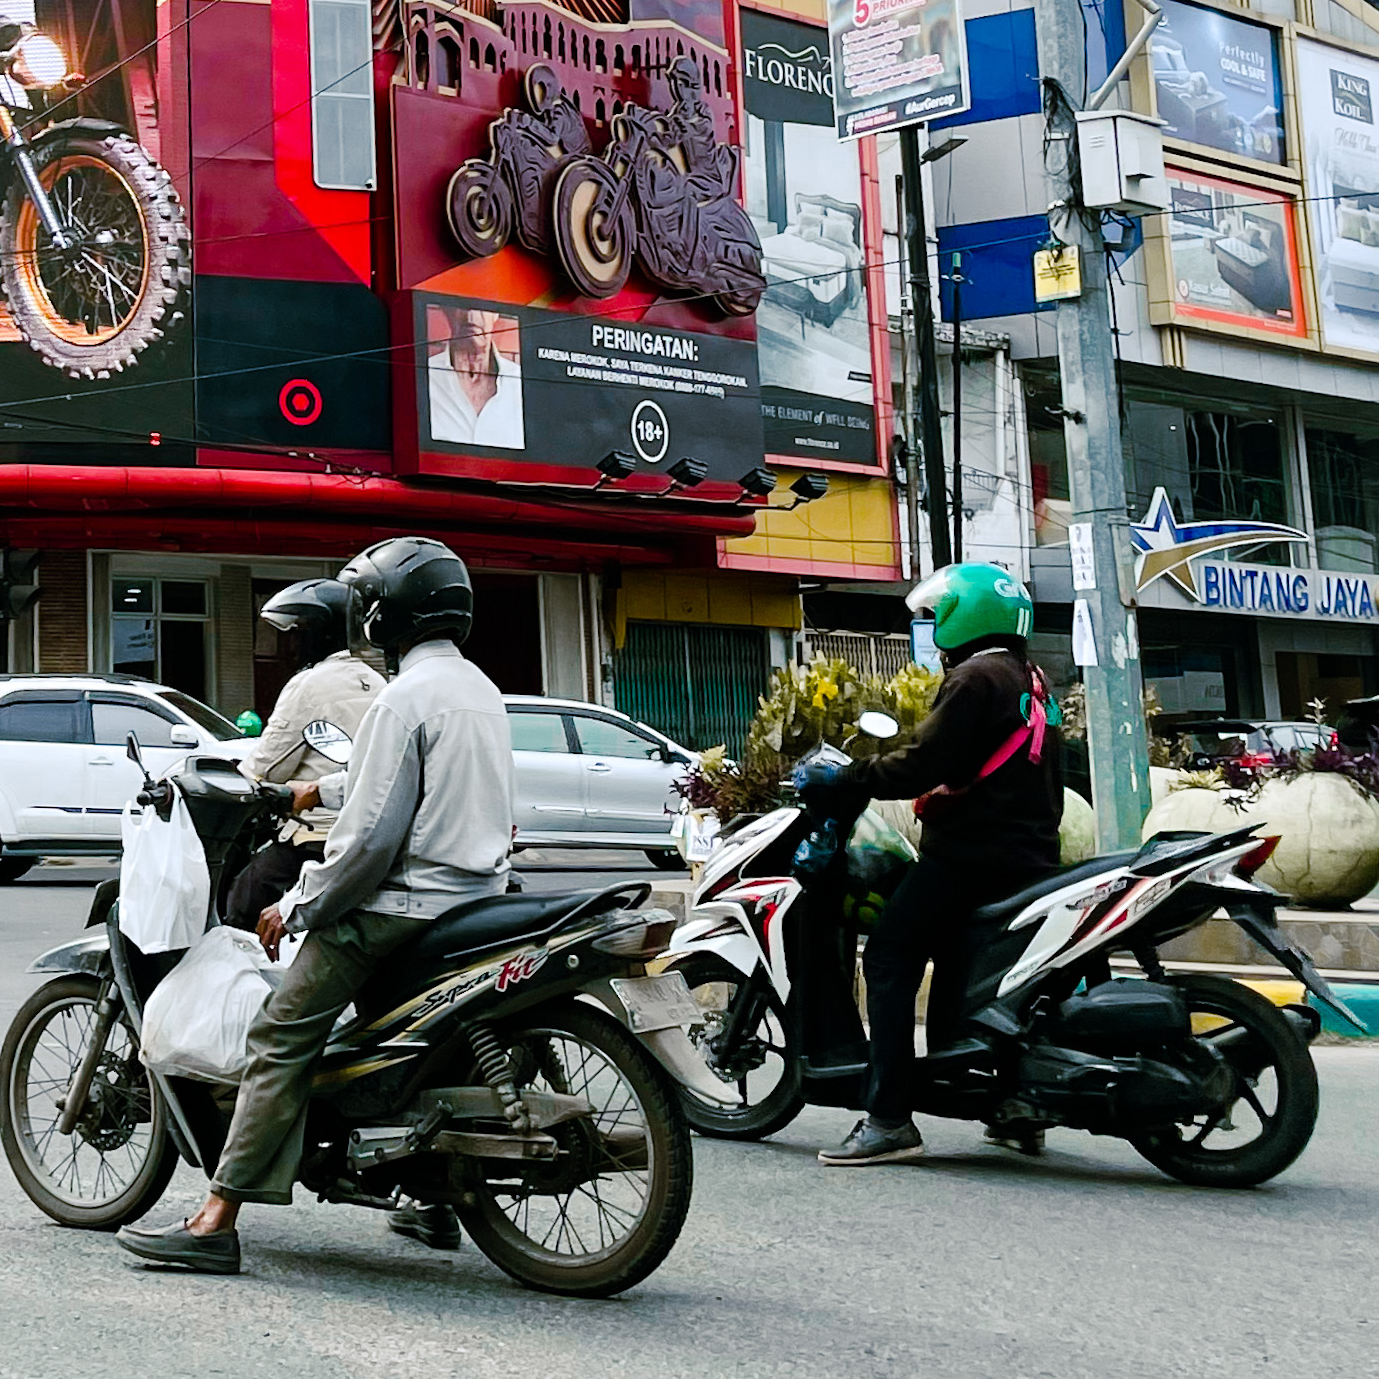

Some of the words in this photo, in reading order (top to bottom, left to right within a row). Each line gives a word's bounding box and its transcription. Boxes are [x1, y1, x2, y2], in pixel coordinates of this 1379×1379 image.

[744, 48, 833, 98] FLORENC
[1220, 57, 1241, 75] COOL
[1248, 66, 1267, 82] SAFE
[1337, 74, 1368, 96] KING
[1335, 97, 1366, 120] KOIL
[592, 325, 700, 362] PERINGATAN:
[760, 404, 777, 418] THE
[777, 406, 813, 422] ELEMENT
[813, 410, 825, 426] of
[825, 413, 846, 427] WELL
[636, 420, 664, 442] 18+
[1204, 565, 1310, 613] BINTANG
[1316, 576, 1374, 618] JAYA
[411, 968, 499, 1018] Supra
[495, 952, 544, 992] Fit
